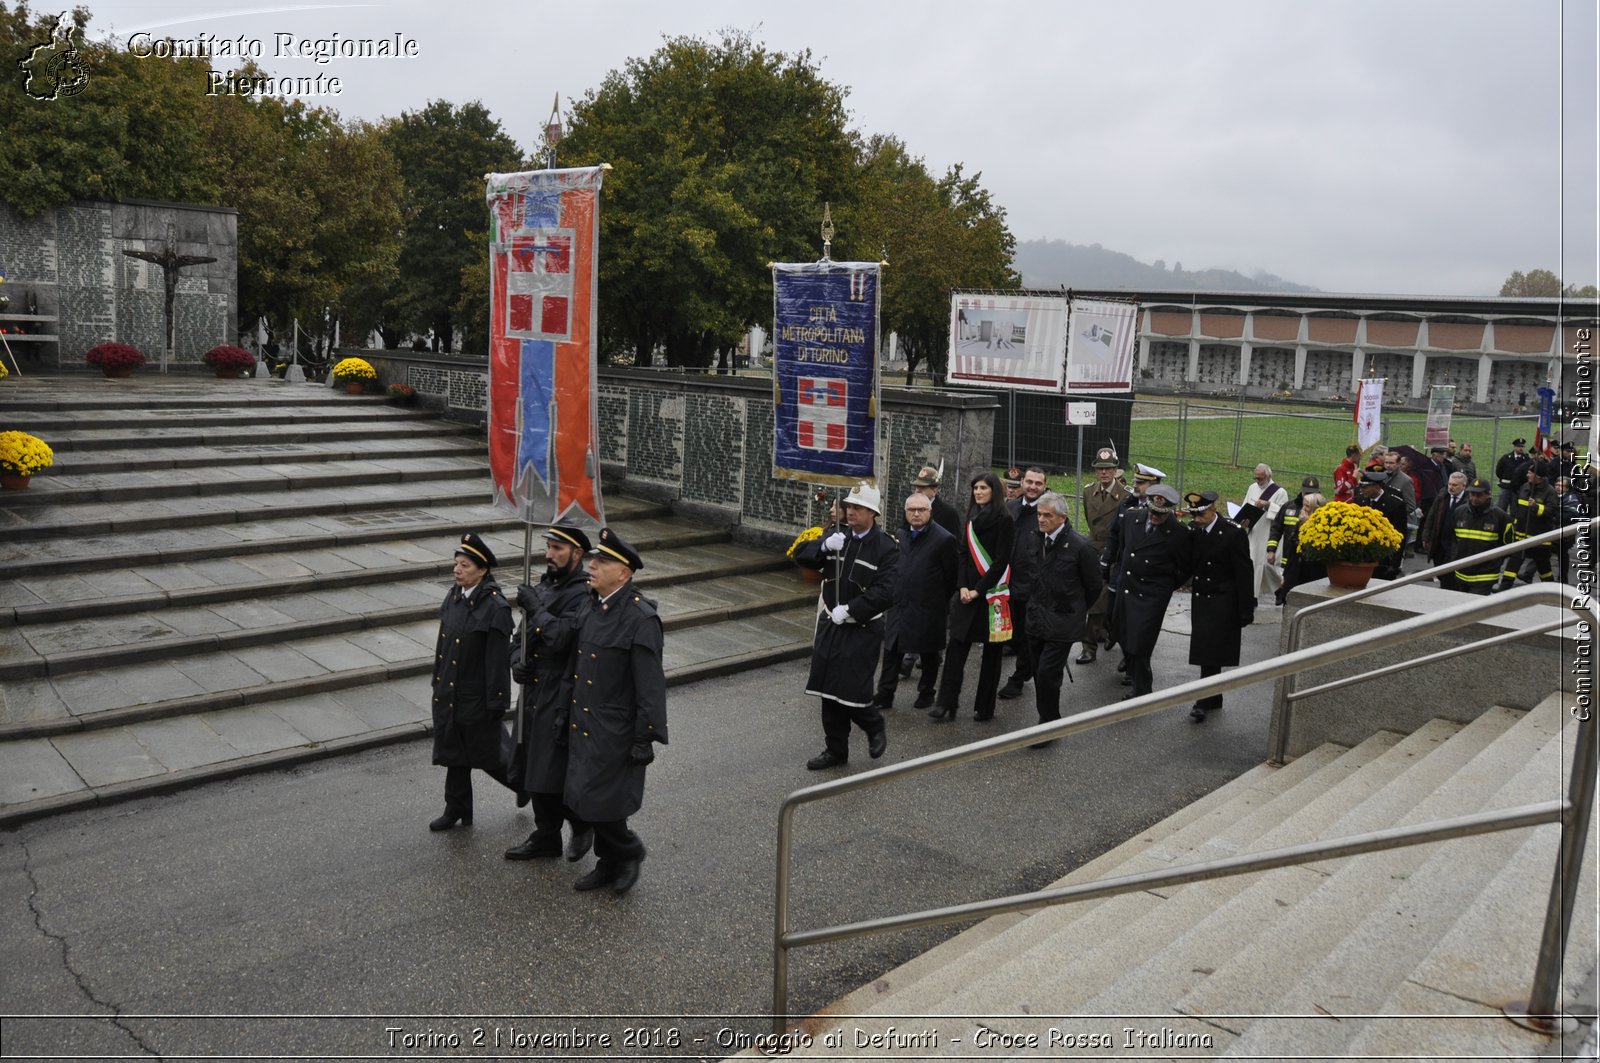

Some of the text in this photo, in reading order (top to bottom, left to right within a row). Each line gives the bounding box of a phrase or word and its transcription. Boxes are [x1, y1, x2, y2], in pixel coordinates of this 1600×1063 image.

[808, 304, 837, 323] CITTÀ
[782, 325, 865, 344] METROPOLITANA
[798, 346, 849, 364] DI TORINO
